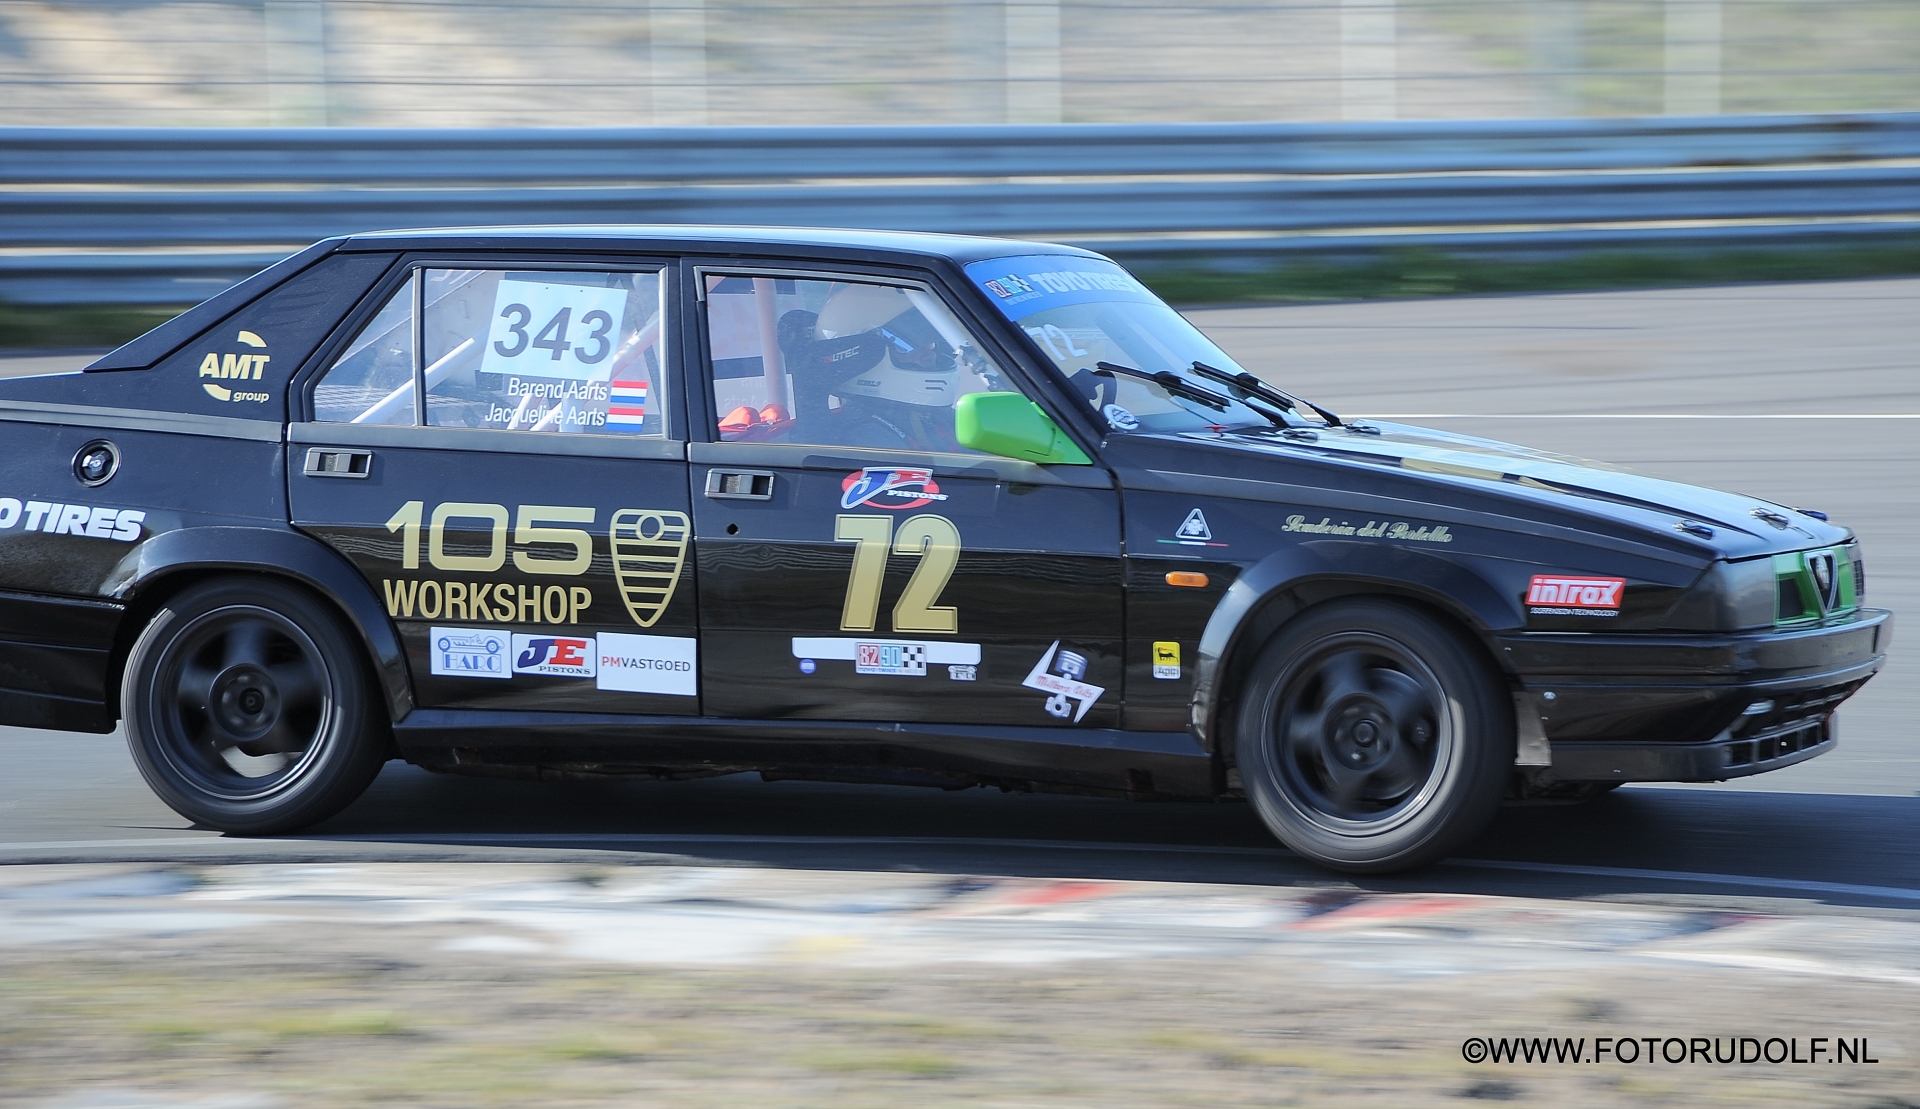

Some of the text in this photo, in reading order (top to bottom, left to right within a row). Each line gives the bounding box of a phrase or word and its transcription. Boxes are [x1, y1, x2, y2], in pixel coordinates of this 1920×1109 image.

[494, 303, 613, 364] 343
[1021, 323, 1088, 361] 72
[199, 352, 270, 380] AMT
[232, 391, 270, 404] group
[508, 377, 608, 401] Barend Aarts
[485, 403, 606, 428] Jacqueline Aarts
[887, 489, 949, 501] PISTONS
[24, 500, 146, 541] TIRES
[385, 500, 596, 575] 105
[834, 513, 961, 633] 72
[383, 579, 592, 624] WORKSHOP
[445, 653, 501, 671] HARC
[517, 638, 587, 669] JE
[602, 656, 691, 673] PMVASTGOED
[539, 665, 591, 675] PISTONS
